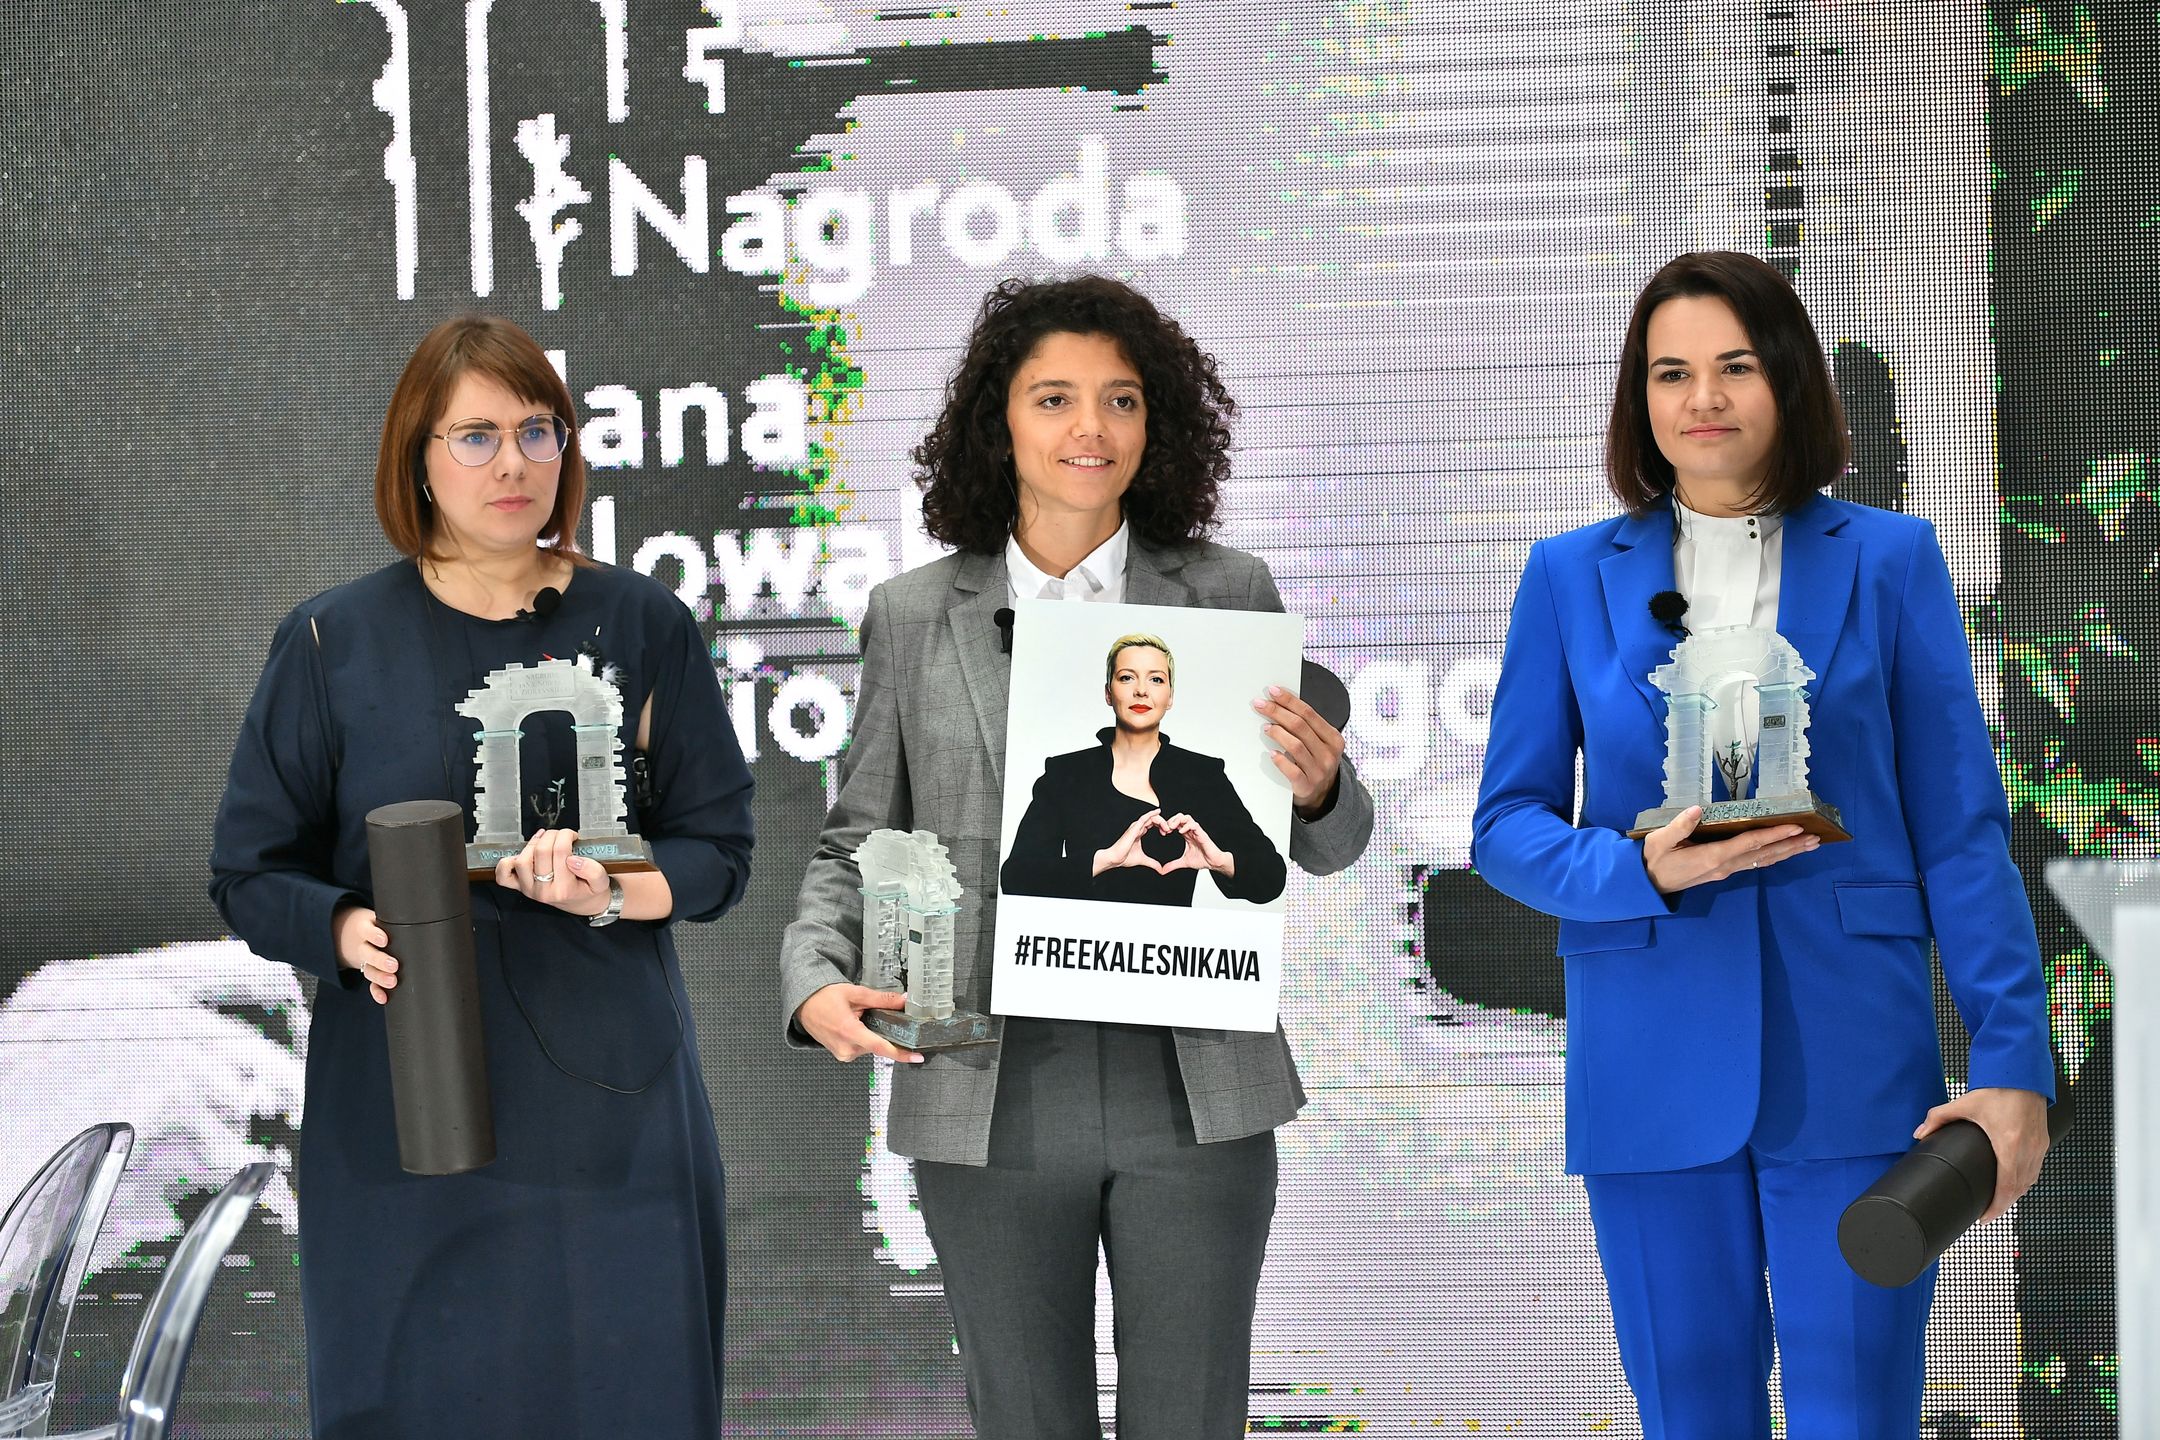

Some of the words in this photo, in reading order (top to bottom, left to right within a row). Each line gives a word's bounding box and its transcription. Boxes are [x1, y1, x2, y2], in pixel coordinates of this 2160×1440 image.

[610, 135, 1190, 305] Nagroda
[545, 350, 807, 471] ana
[1014, 935, 1260, 982] #FREEKALESNIKAVA
